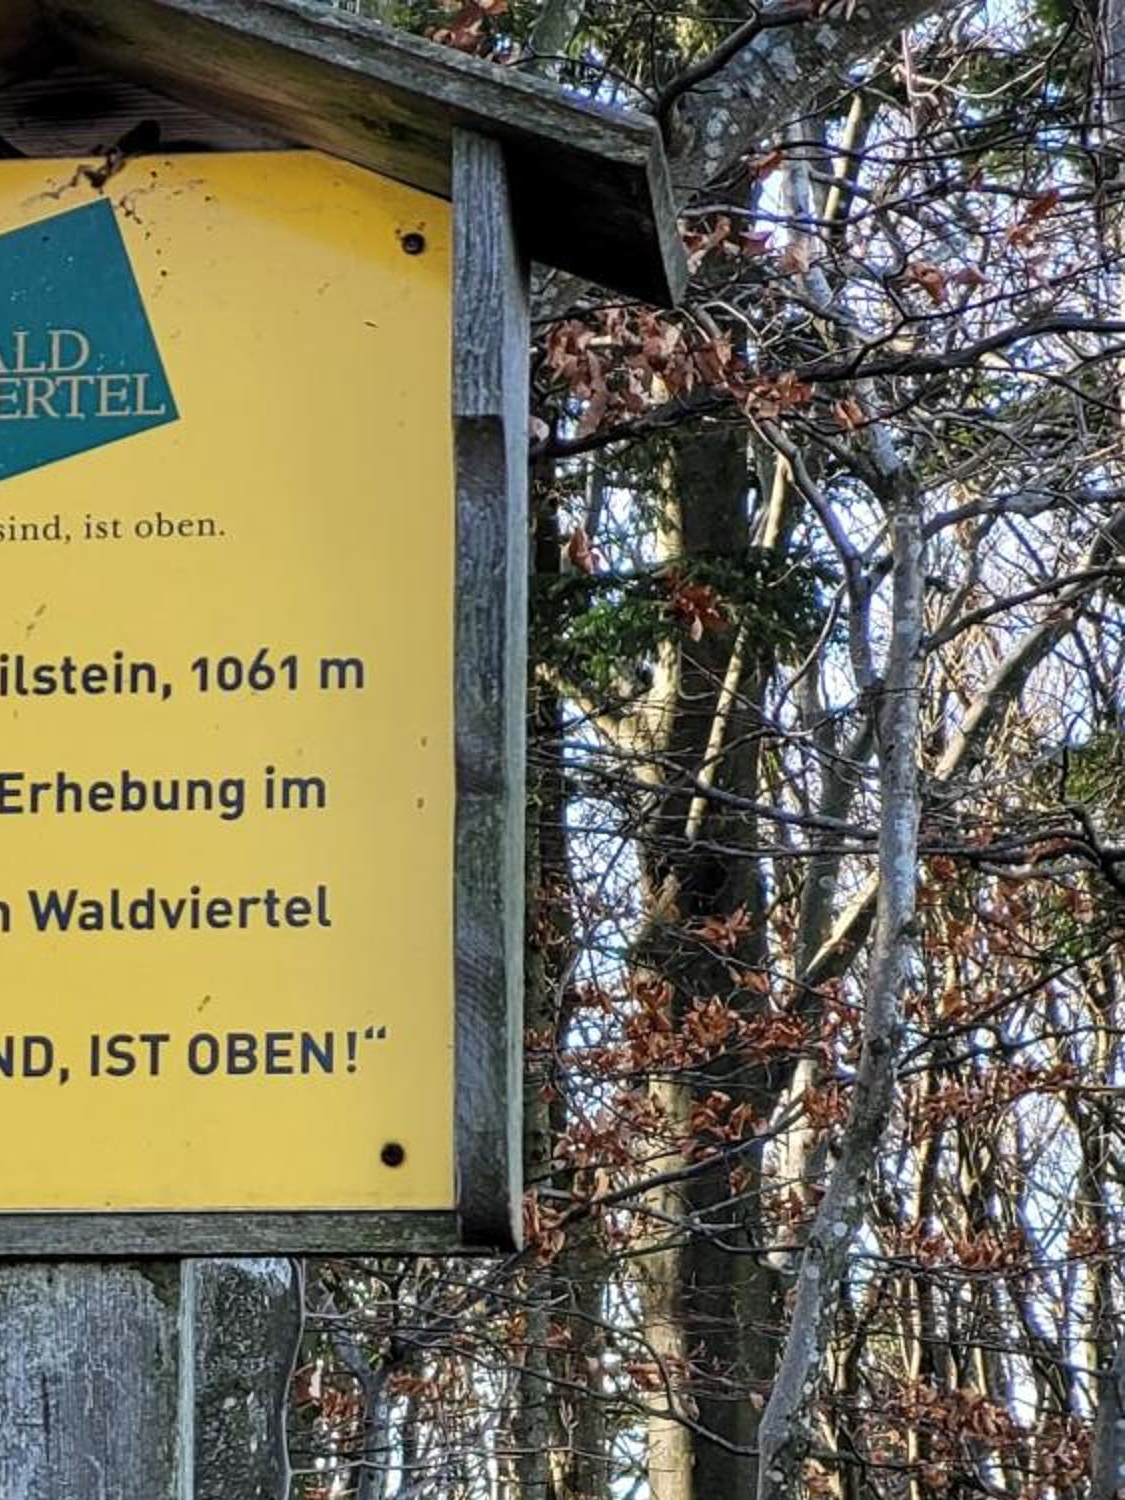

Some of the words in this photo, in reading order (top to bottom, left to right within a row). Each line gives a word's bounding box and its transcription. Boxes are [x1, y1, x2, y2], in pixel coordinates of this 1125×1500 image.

[84, 513, 123, 541] ist
[134, 511, 226, 540] oben.
[190, 647, 299, 694] 1061
[319, 657, 365, 691] m
[264, 764, 327, 810] im
[27, 884, 332, 933] Waldviertel
[90, 1033, 171, 1078] IST
[187, 1026, 387, 1077] OBEN!“
